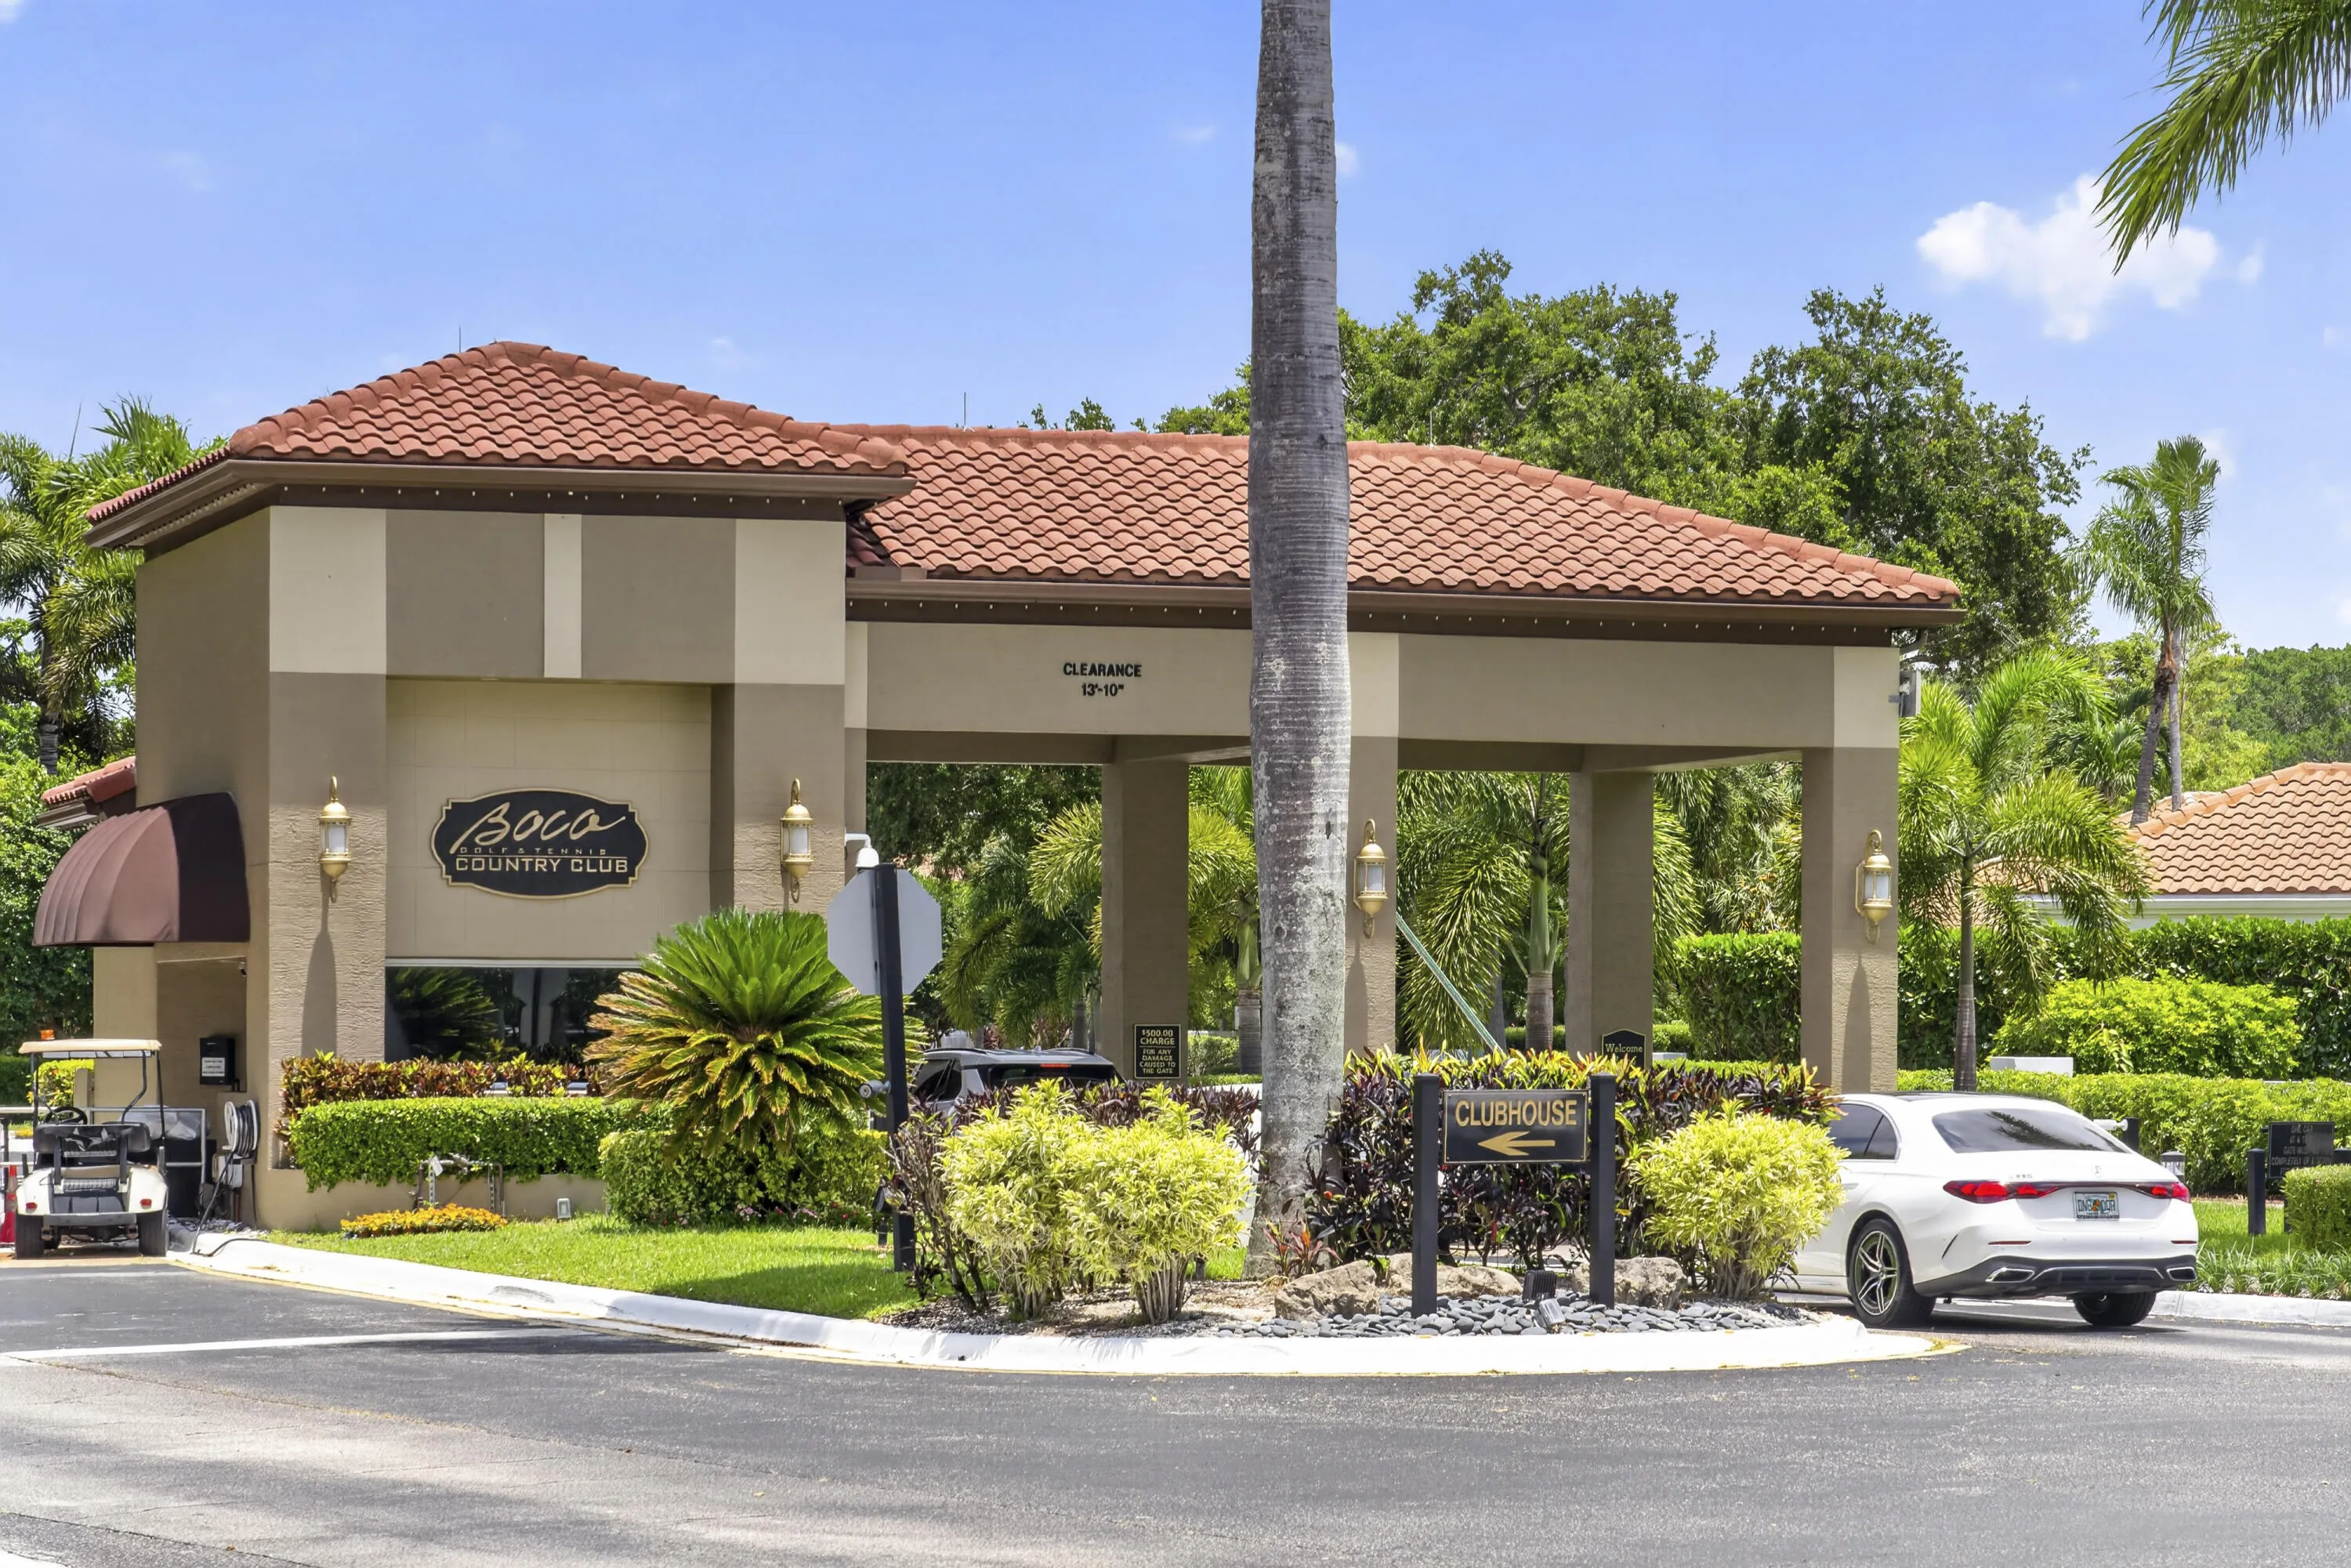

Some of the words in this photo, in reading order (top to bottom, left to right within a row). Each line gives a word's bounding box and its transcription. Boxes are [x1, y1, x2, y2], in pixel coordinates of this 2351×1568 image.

[1063, 662, 1142, 678] CLEARANCE
[1081, 683, 1125, 697] 13'-10"
[449, 802, 626, 854] Boca
[534, 847, 607, 856] TENNIS
[455, 857, 562, 872] COUNTRY
[571, 858, 628, 873] CLUB
[1141, 1029, 1174, 1037] $500.00
[1605, 1043, 1643, 1053] Welcome
[1454, 1099, 1578, 1127] CLUBHOUSE
